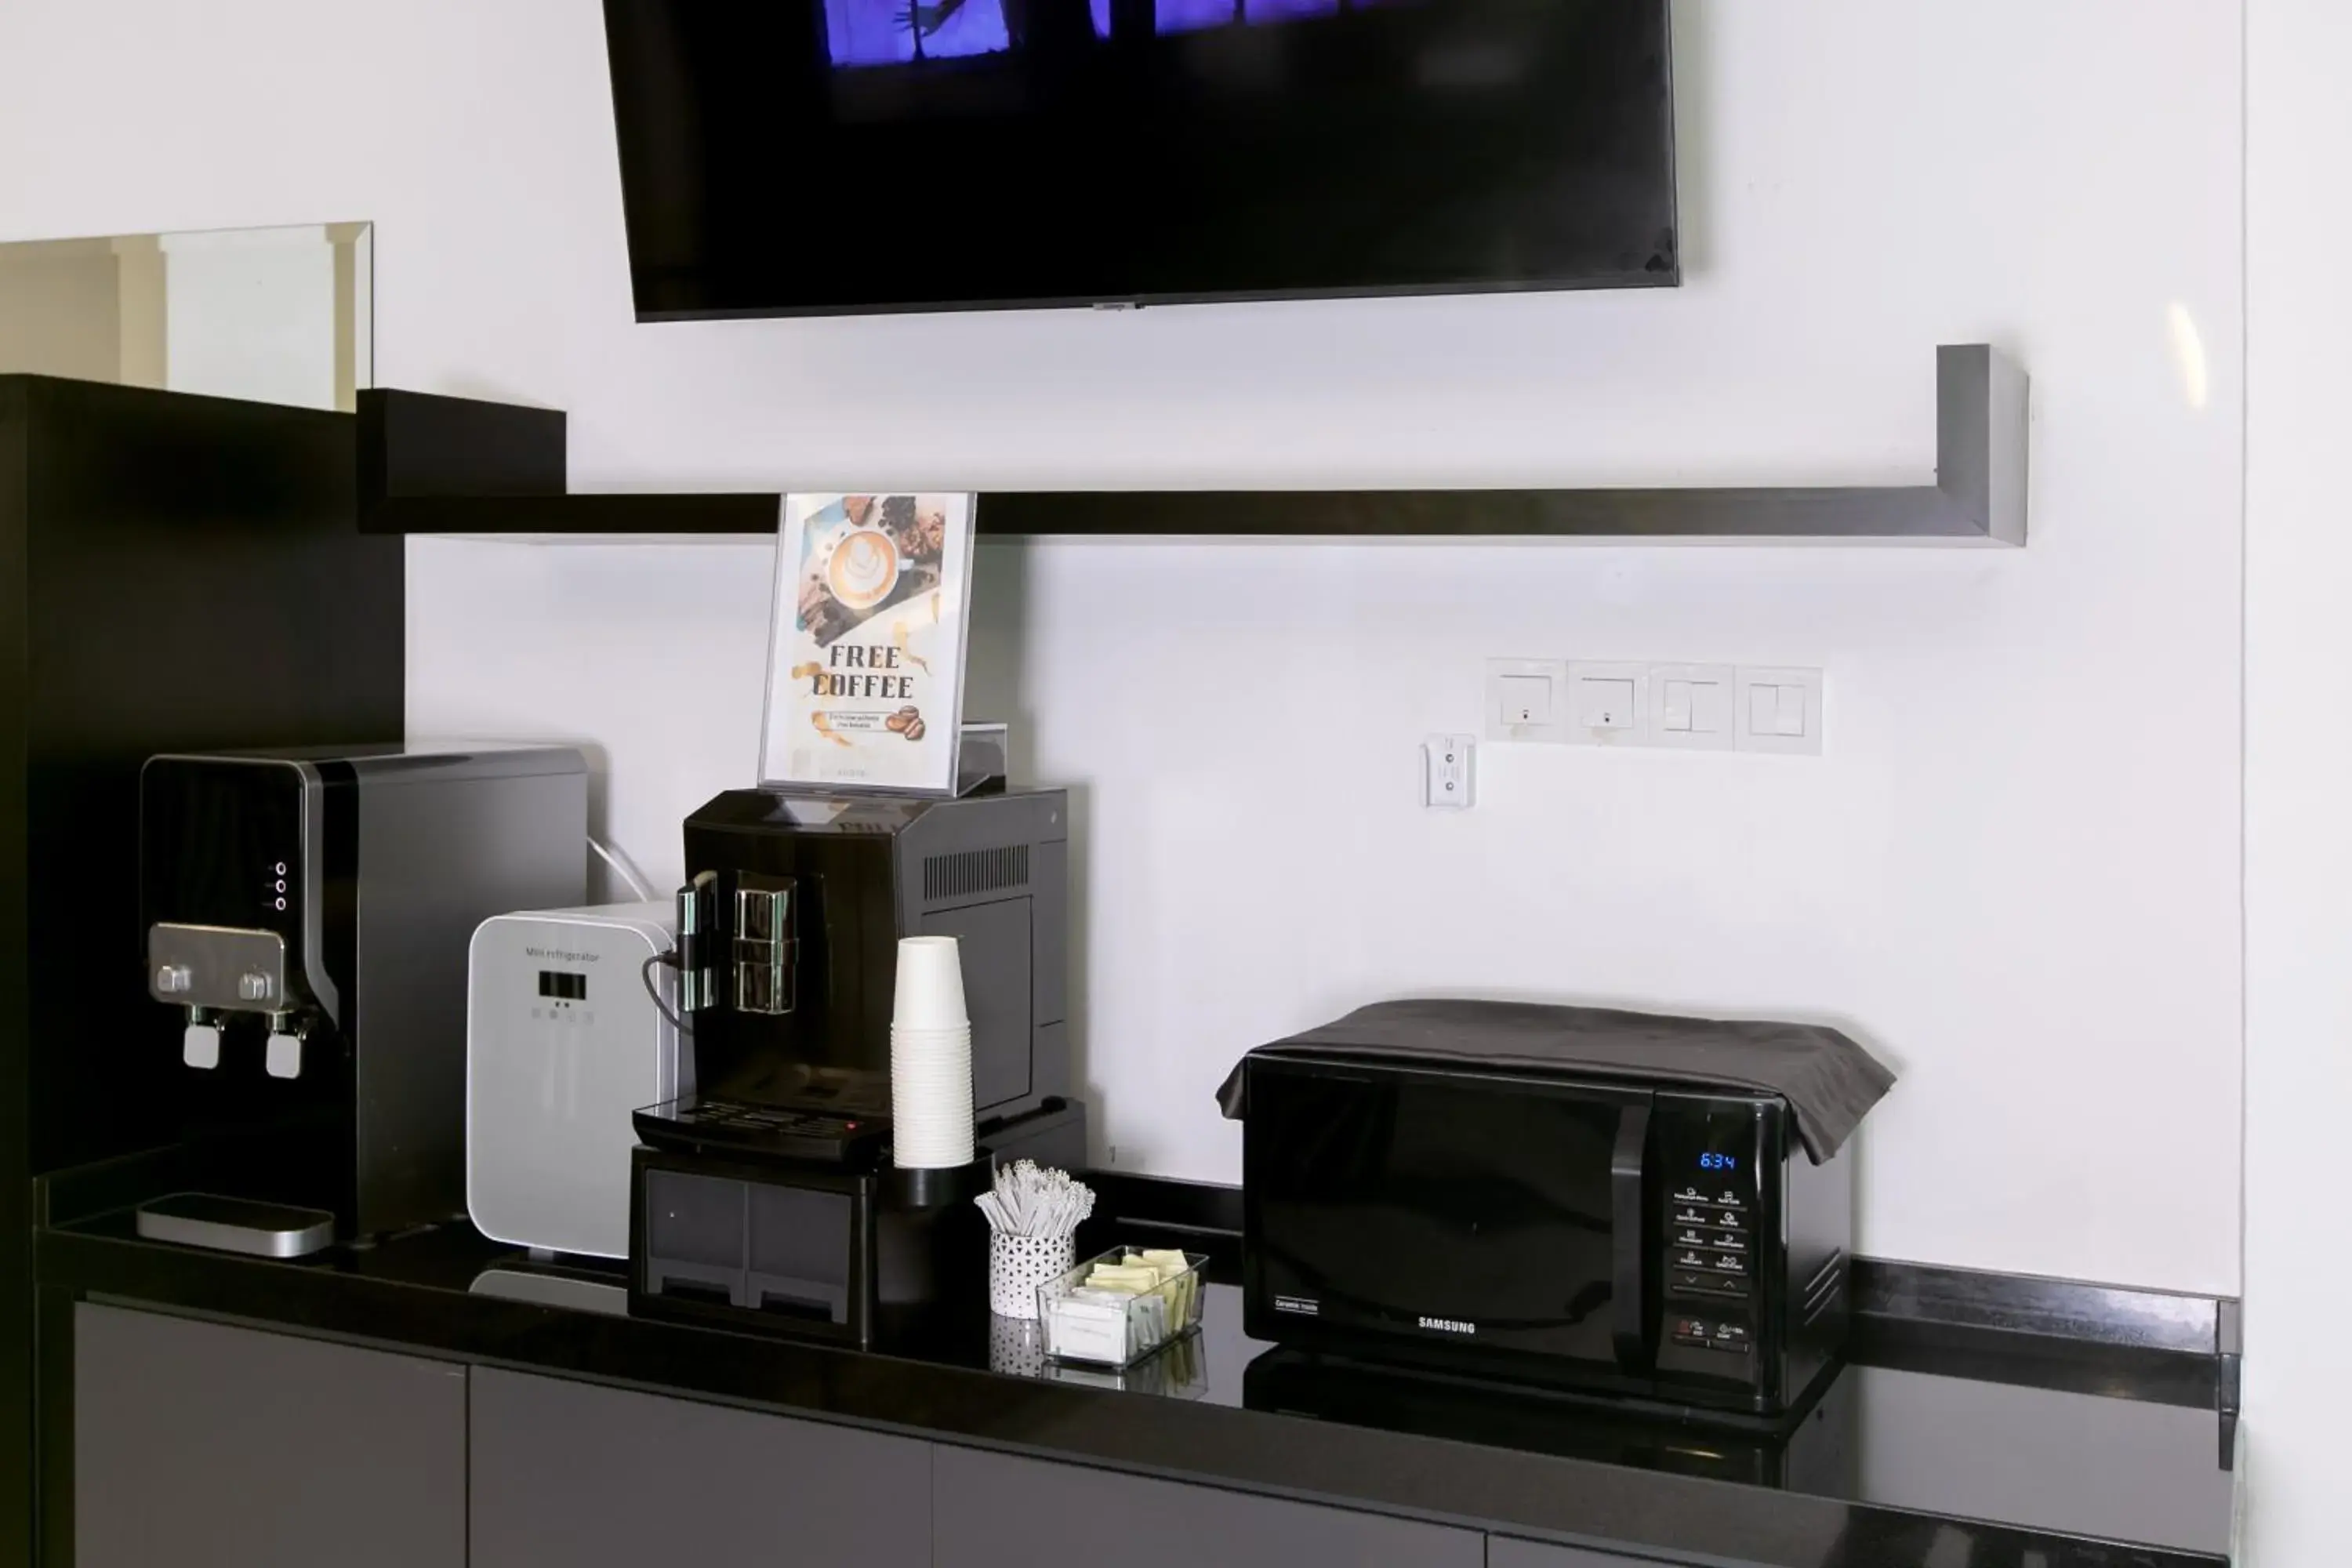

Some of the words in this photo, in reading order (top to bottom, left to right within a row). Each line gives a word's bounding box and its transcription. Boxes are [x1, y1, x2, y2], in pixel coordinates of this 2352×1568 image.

[830, 644, 901, 669] FREE
[813, 673, 913, 699] COFFEE
[546, 948, 600, 962] refrigerator
[1418, 1316, 1475, 1334] SAMSUNG
